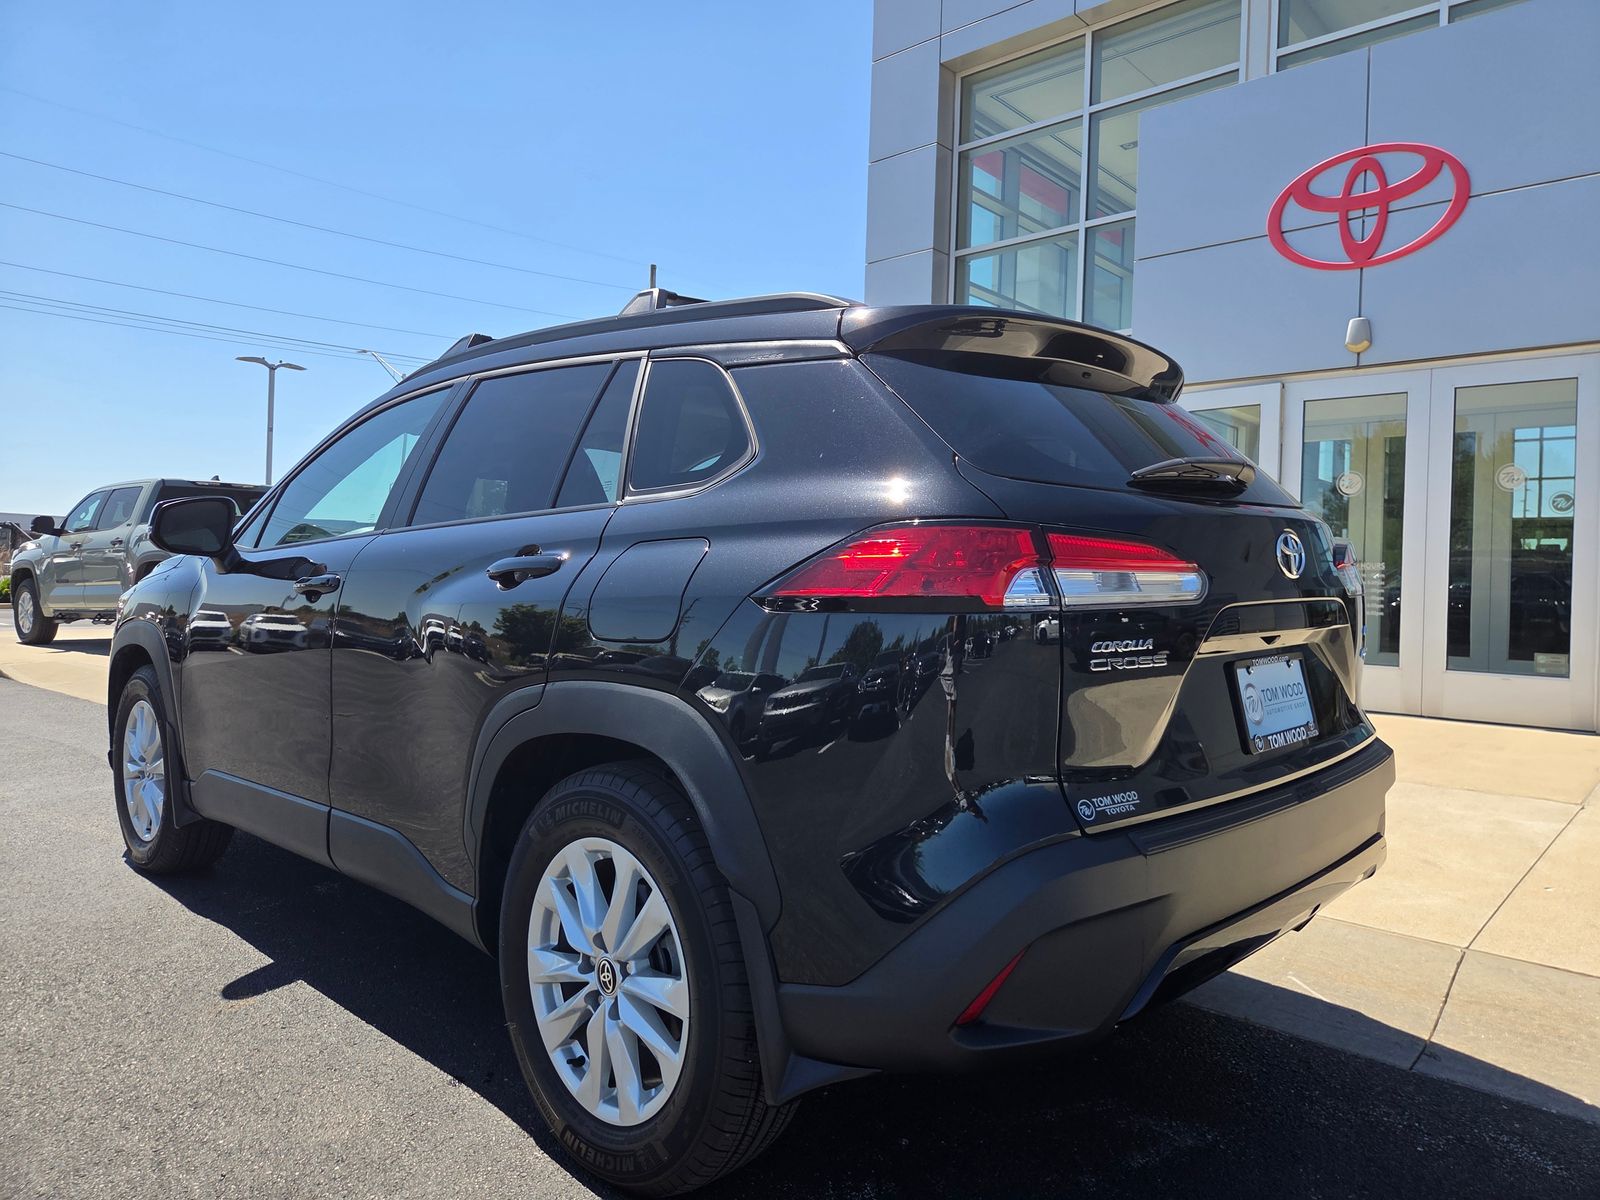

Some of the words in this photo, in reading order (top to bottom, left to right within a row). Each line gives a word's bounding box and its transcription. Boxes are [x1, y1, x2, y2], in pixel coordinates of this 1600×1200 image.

[1091, 638, 1154, 653] COROLLA
[1090, 654, 1167, 671] CROSS
[1261, 688, 1280, 702] TOM
[1280, 682, 1304, 698] WOOD
[1268, 733, 1285, 749] TOM
[1285, 727, 1307, 746] WOOD
[1092, 795, 1113, 808] TOM
[1112, 791, 1138, 803] WOOD
[555, 801, 623, 824] MICHELIN
[1105, 805, 1136, 815] TOYOTA
[563, 1130, 635, 1172] MICHELIN
